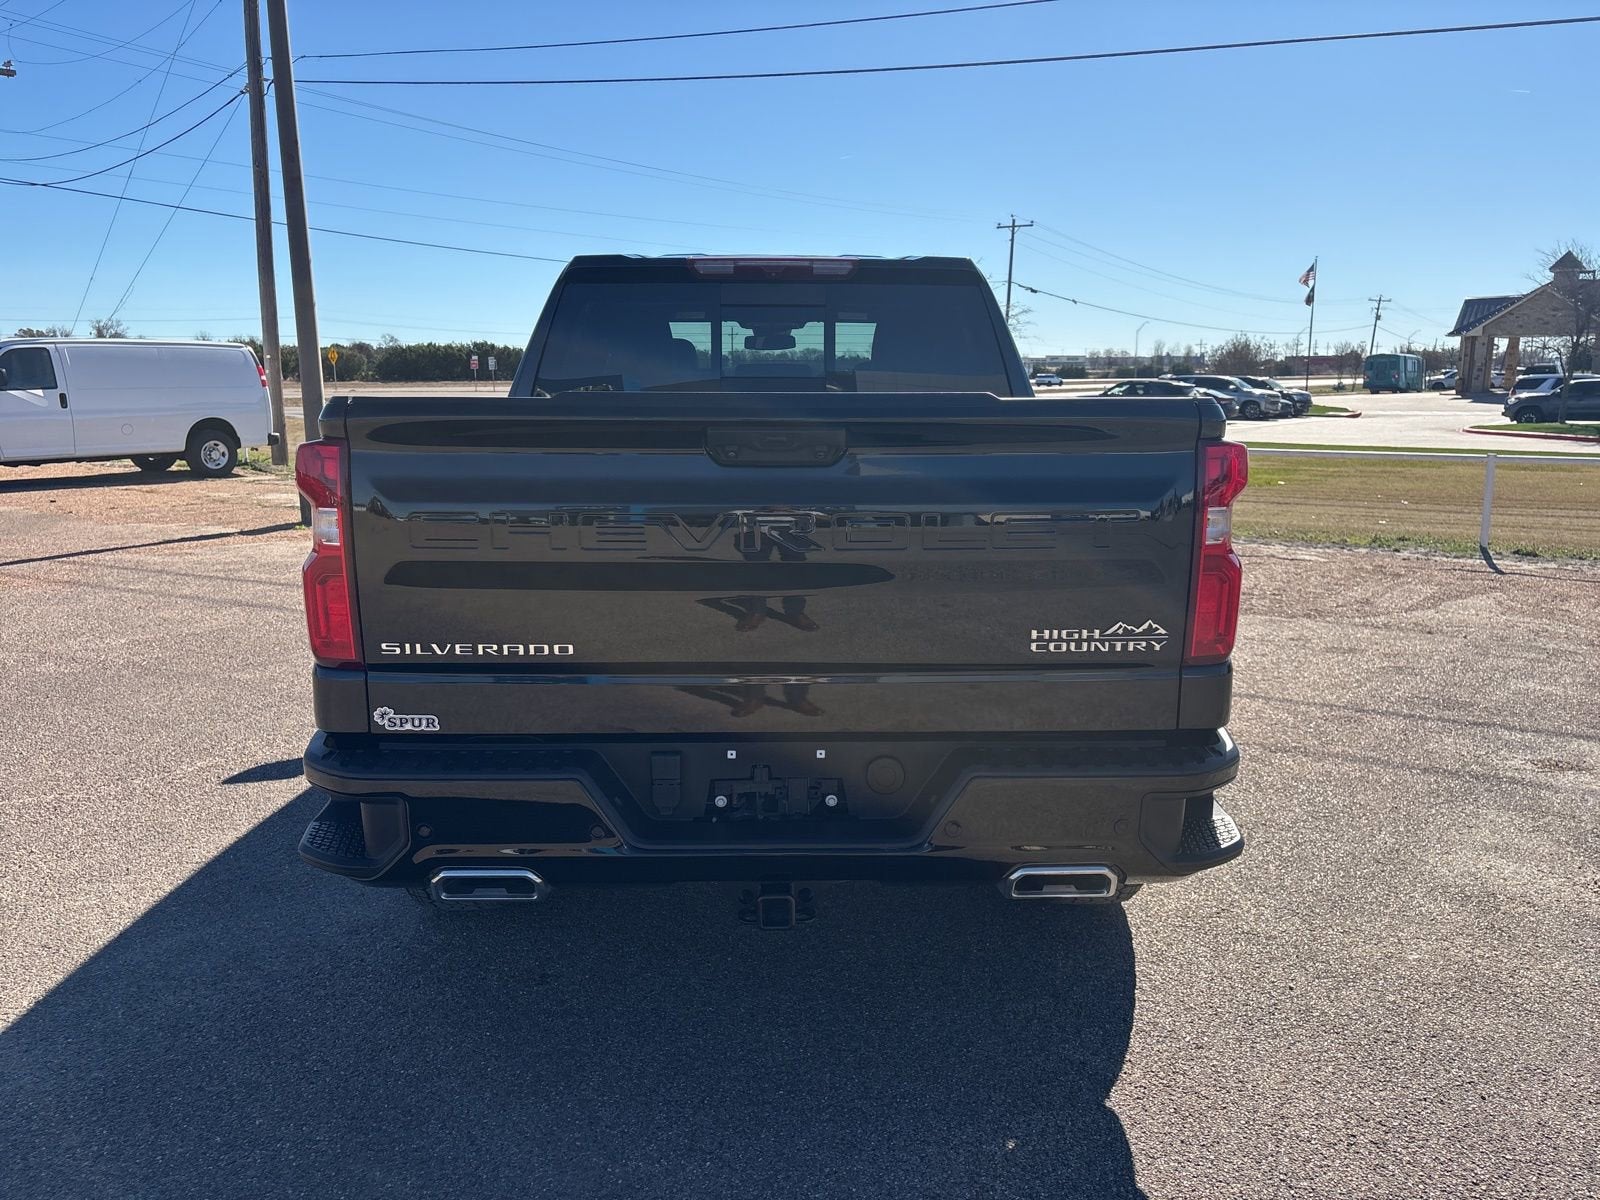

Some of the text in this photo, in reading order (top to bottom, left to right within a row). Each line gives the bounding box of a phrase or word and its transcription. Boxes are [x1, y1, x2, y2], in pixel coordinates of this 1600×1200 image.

[408, 508, 1143, 552] CHEVROLET
[1030, 629, 1100, 640] HIGH
[380, 642, 575, 656] SILVERADO
[1030, 640, 1167, 652] COUNTRY
[387, 717, 437, 728] SPUR
